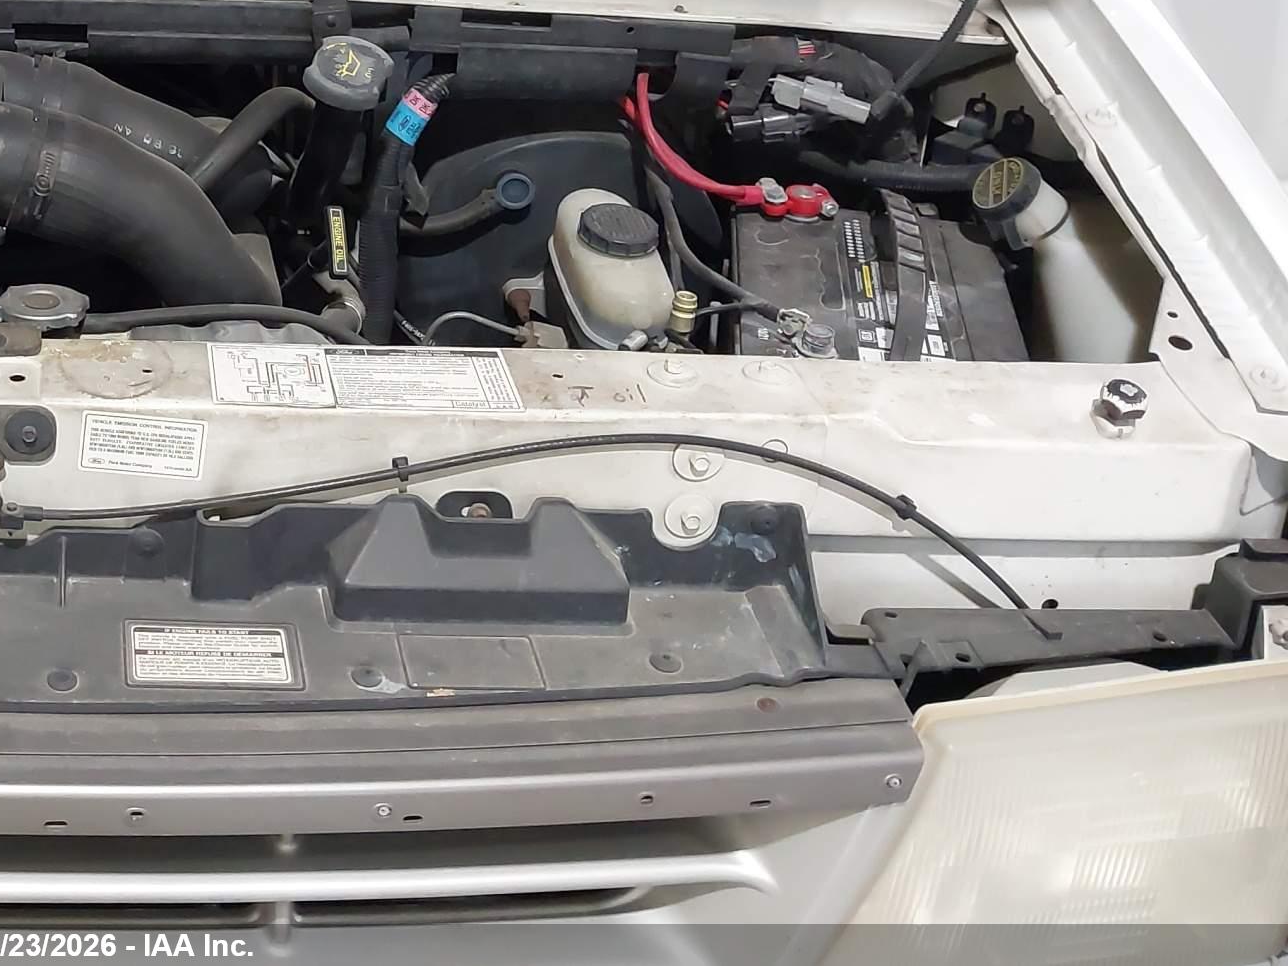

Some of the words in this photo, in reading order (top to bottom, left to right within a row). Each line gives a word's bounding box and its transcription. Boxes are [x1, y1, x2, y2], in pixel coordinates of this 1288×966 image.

[333, 216, 343, 247] ENGINE
[336, 249, 345, 263] OIL
[139, 422, 162, 430] CONTROL
